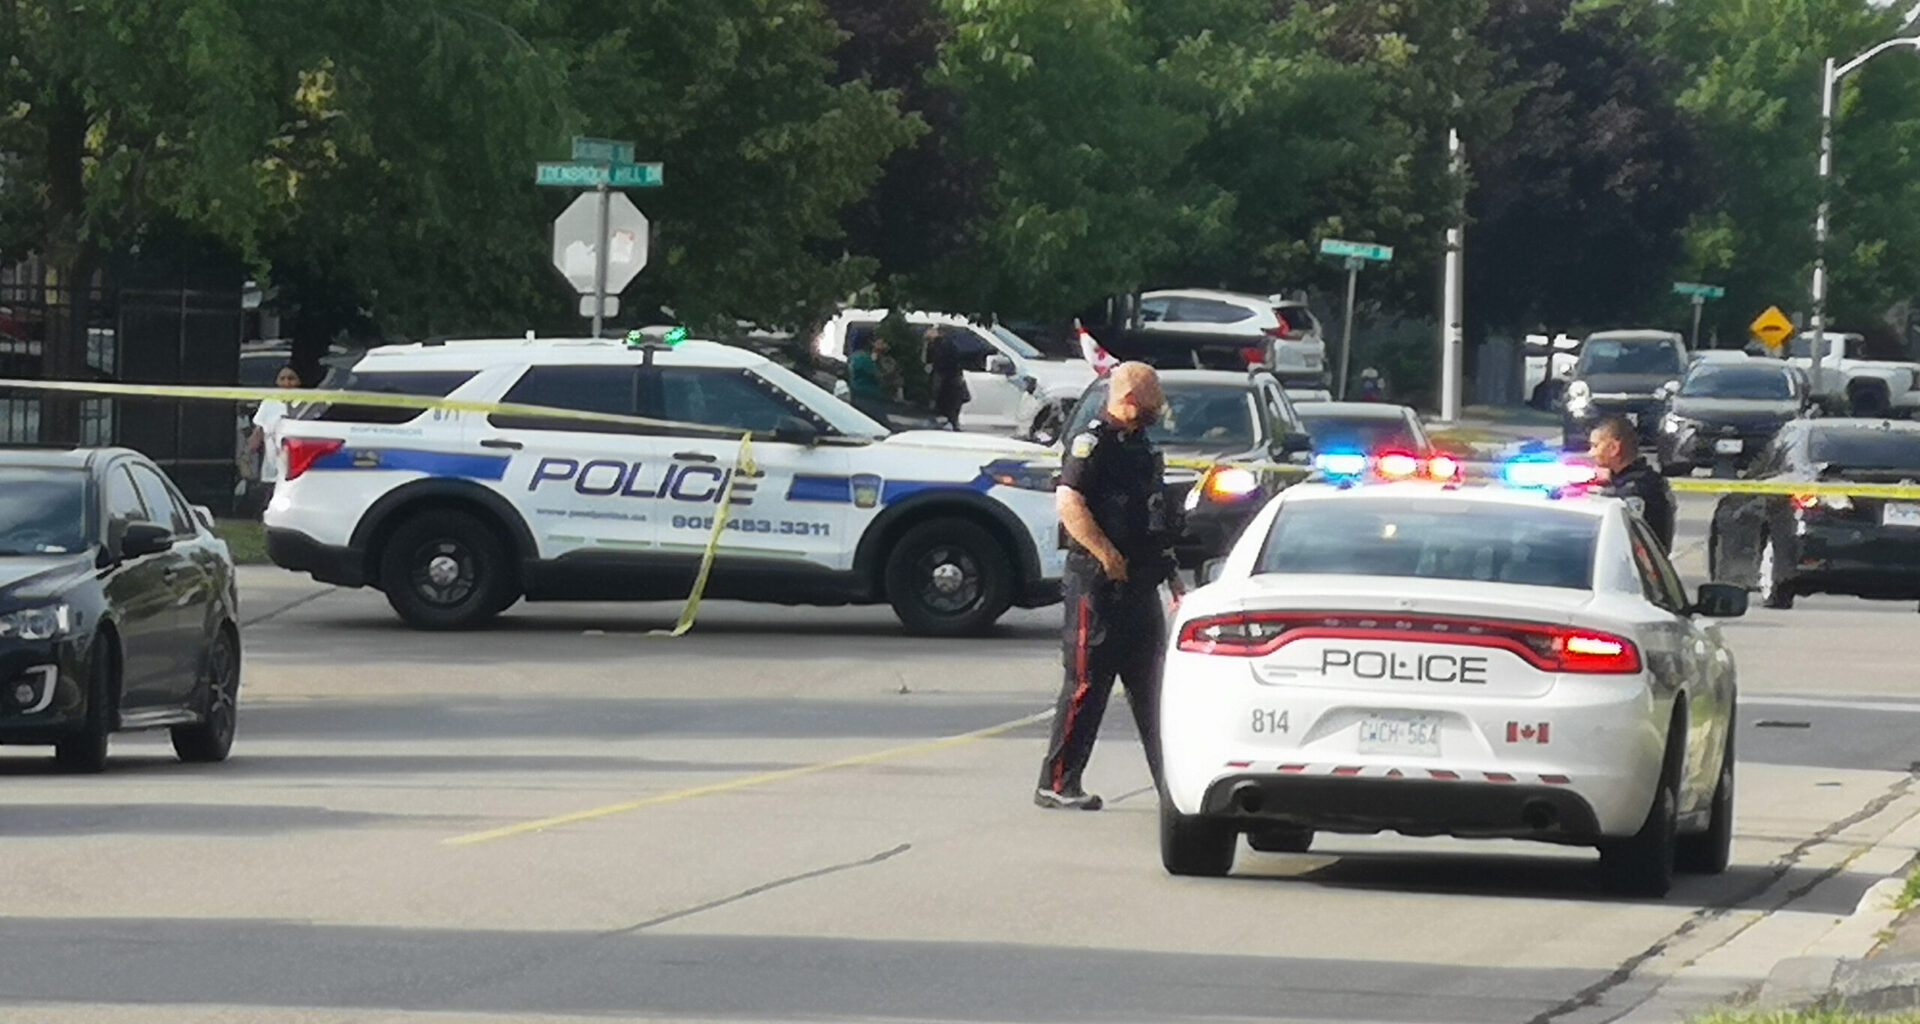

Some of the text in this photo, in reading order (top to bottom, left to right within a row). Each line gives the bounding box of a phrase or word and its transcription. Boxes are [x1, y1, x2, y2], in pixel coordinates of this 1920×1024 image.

[528, 456, 766, 506] POLICE
[1321, 648, 1488, 685] POLICE
[1252, 708, 1290, 734] 814
